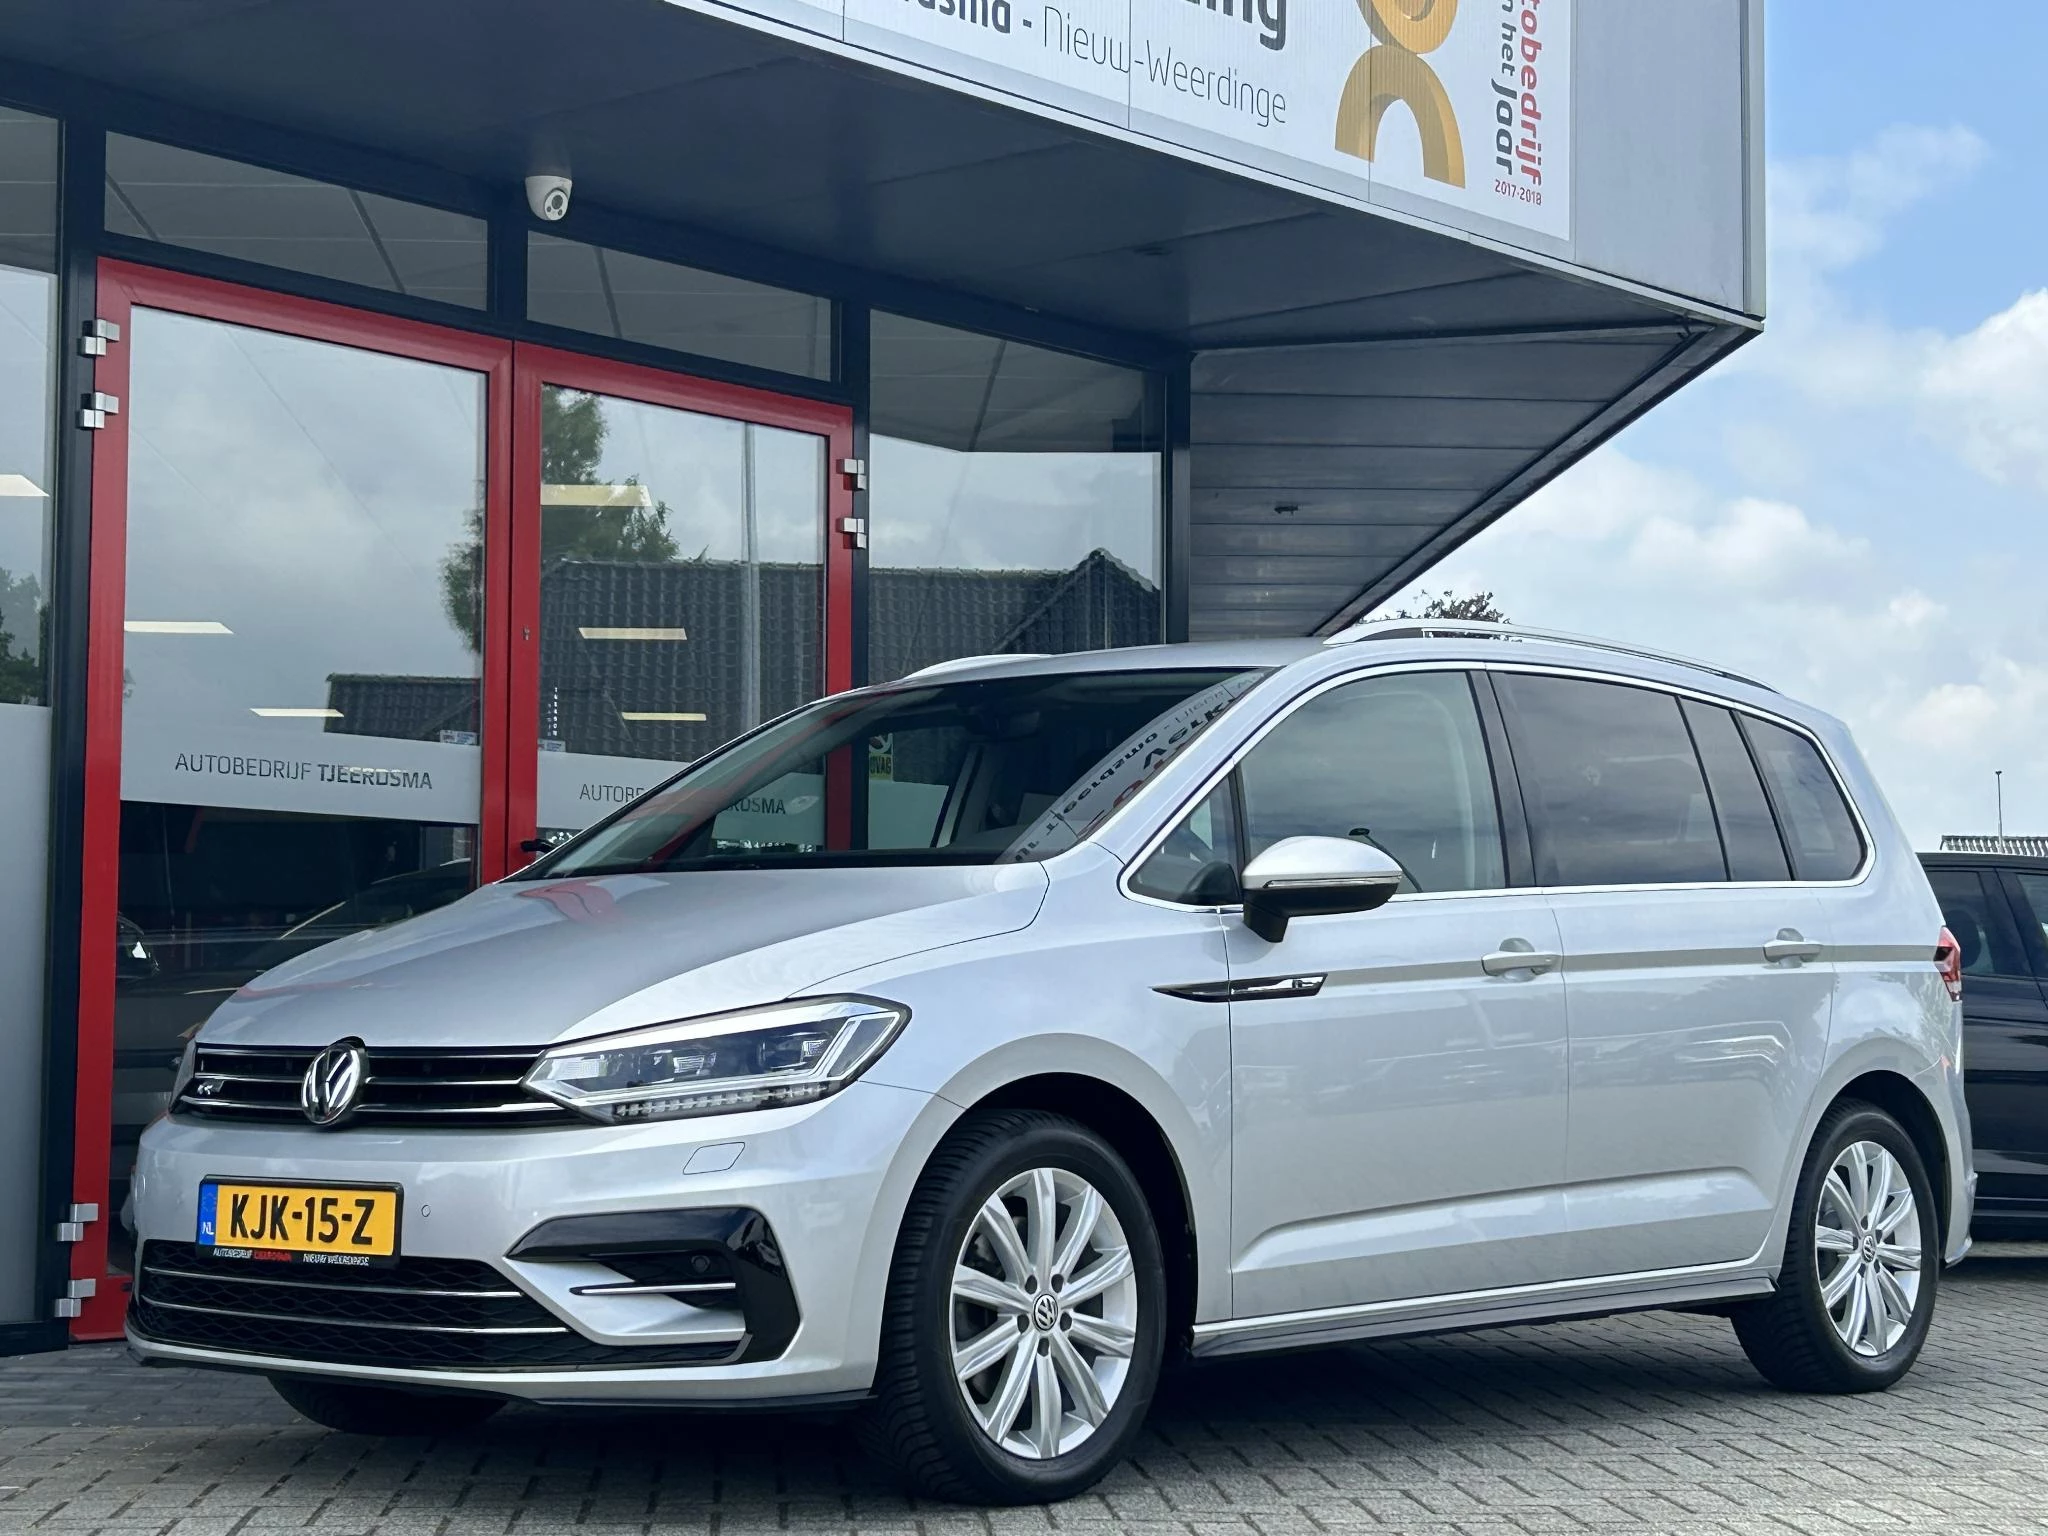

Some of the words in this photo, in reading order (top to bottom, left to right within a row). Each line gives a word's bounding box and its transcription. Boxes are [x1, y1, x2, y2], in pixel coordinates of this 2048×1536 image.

[1501, 22, 1517, 77] het
[174, 752, 312, 781] AUTOBEDRIJF
[317, 762, 433, 790] TJEERDSMA
[230, 1193, 375, 1246] KJK-15-Z
